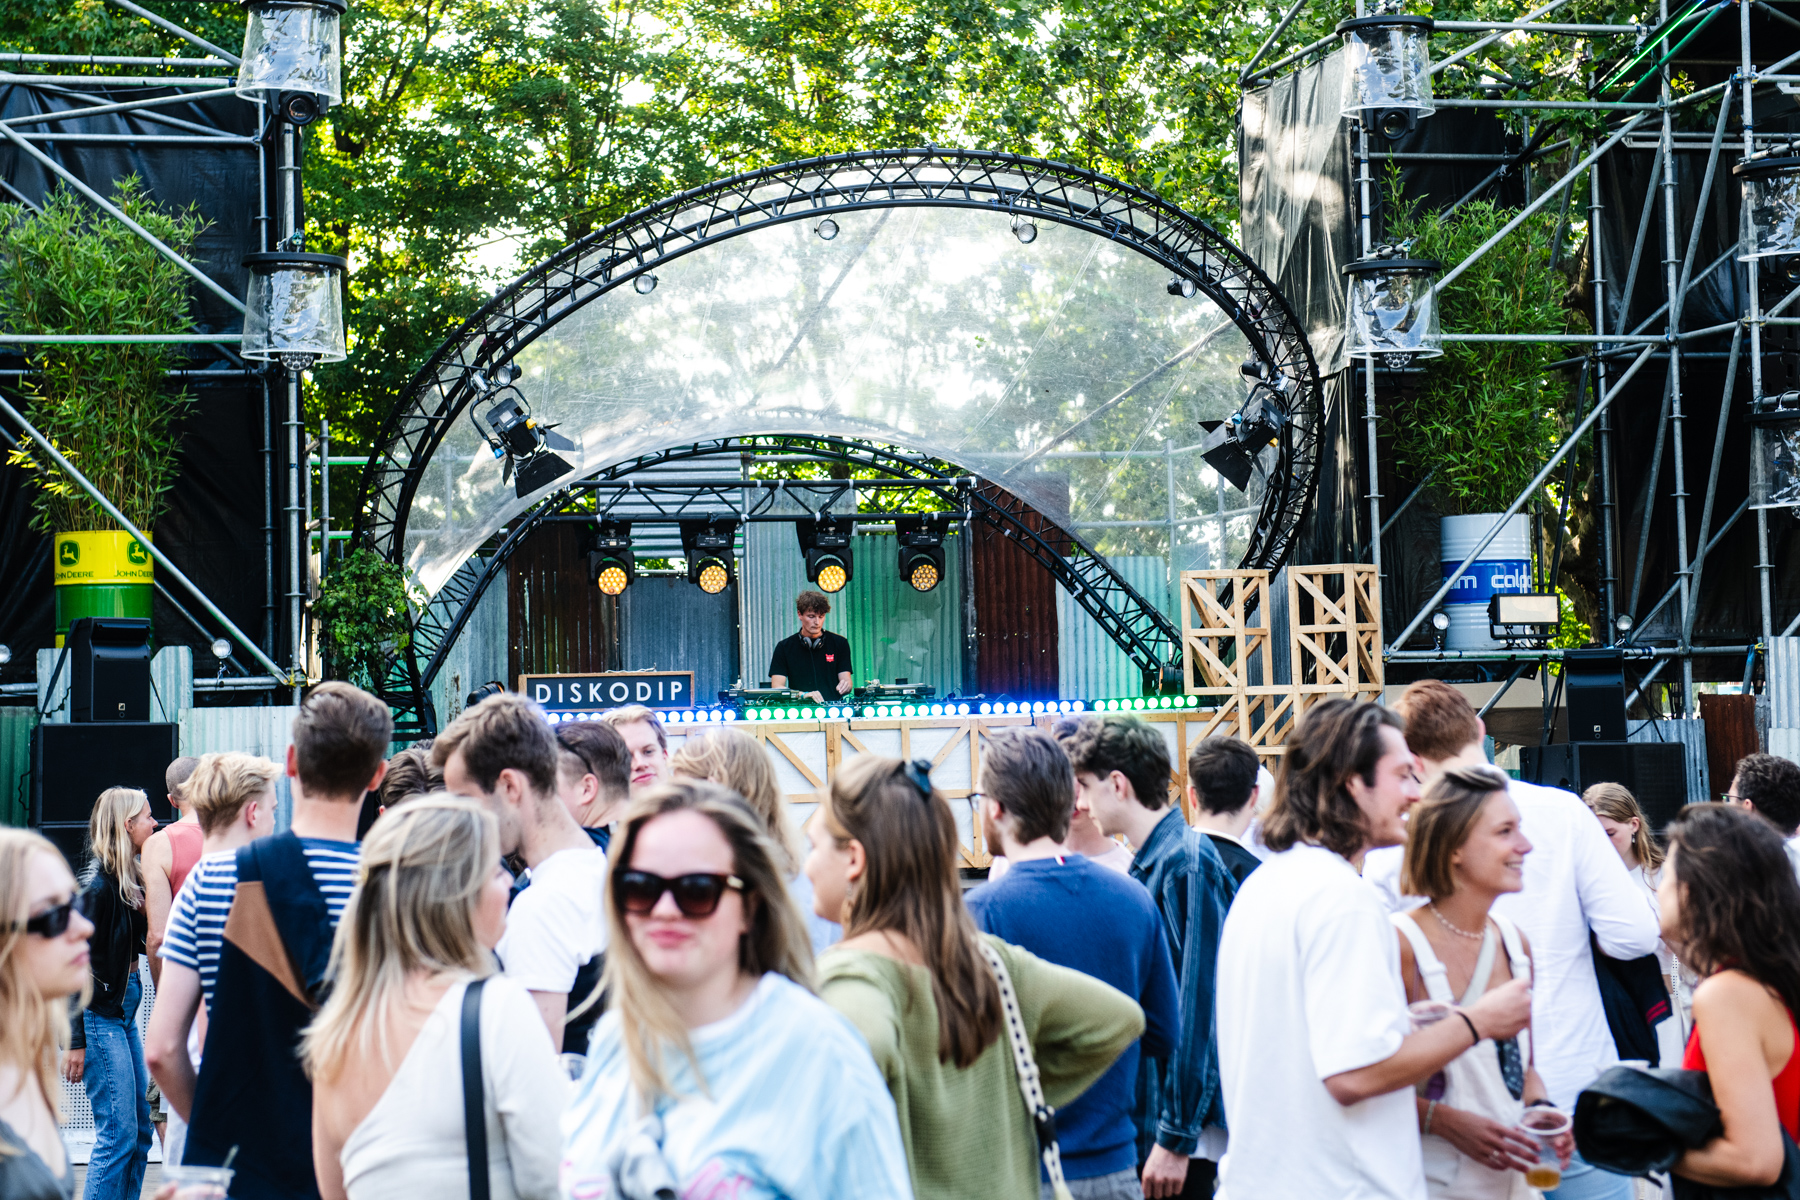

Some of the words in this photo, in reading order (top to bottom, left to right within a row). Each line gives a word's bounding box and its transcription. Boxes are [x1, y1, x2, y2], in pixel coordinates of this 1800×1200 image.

[67, 570, 94, 579] DEERE
[113, 569, 138, 578] JOHN
[535, 681, 683, 704] DISKODIP
